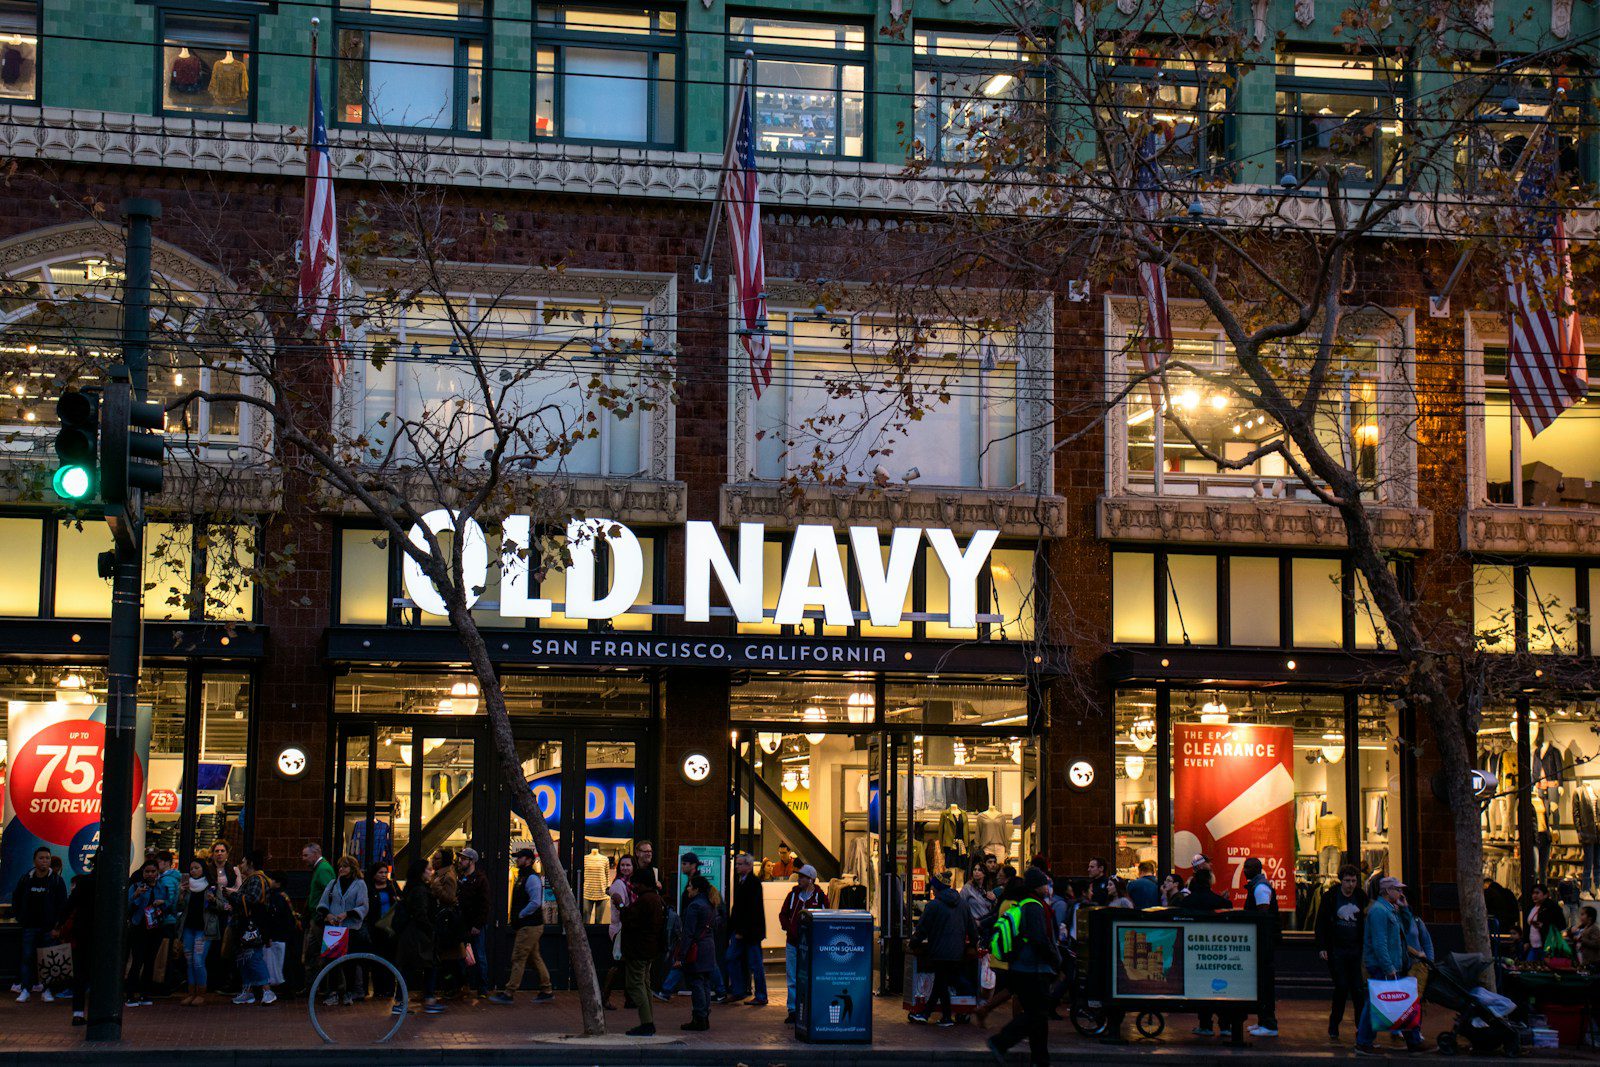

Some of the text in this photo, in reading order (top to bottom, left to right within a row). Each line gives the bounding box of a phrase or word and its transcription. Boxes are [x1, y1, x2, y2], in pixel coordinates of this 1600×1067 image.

[403, 509, 999, 628] OLD NAVY
[531, 639, 886, 663] SAN FRANCISCO, CALIFORNIA
[69, 732, 89, 740] UP TO
[1184, 731, 1204, 739] THE
[1183, 742, 1276, 758] CLEARANCE
[1184, 758, 1215, 767] EVENT
[33, 745, 105, 793] 75
[150, 793, 174, 807] 75%
[29, 798, 101, 813] STOREWI
[1227, 847, 1251, 856] UP TO
[1187, 935, 1249, 943] GIRL SCOUTS
[1228, 944, 1251, 952] THEIR
[1196, 963, 1244, 971] SALESFORCE.
